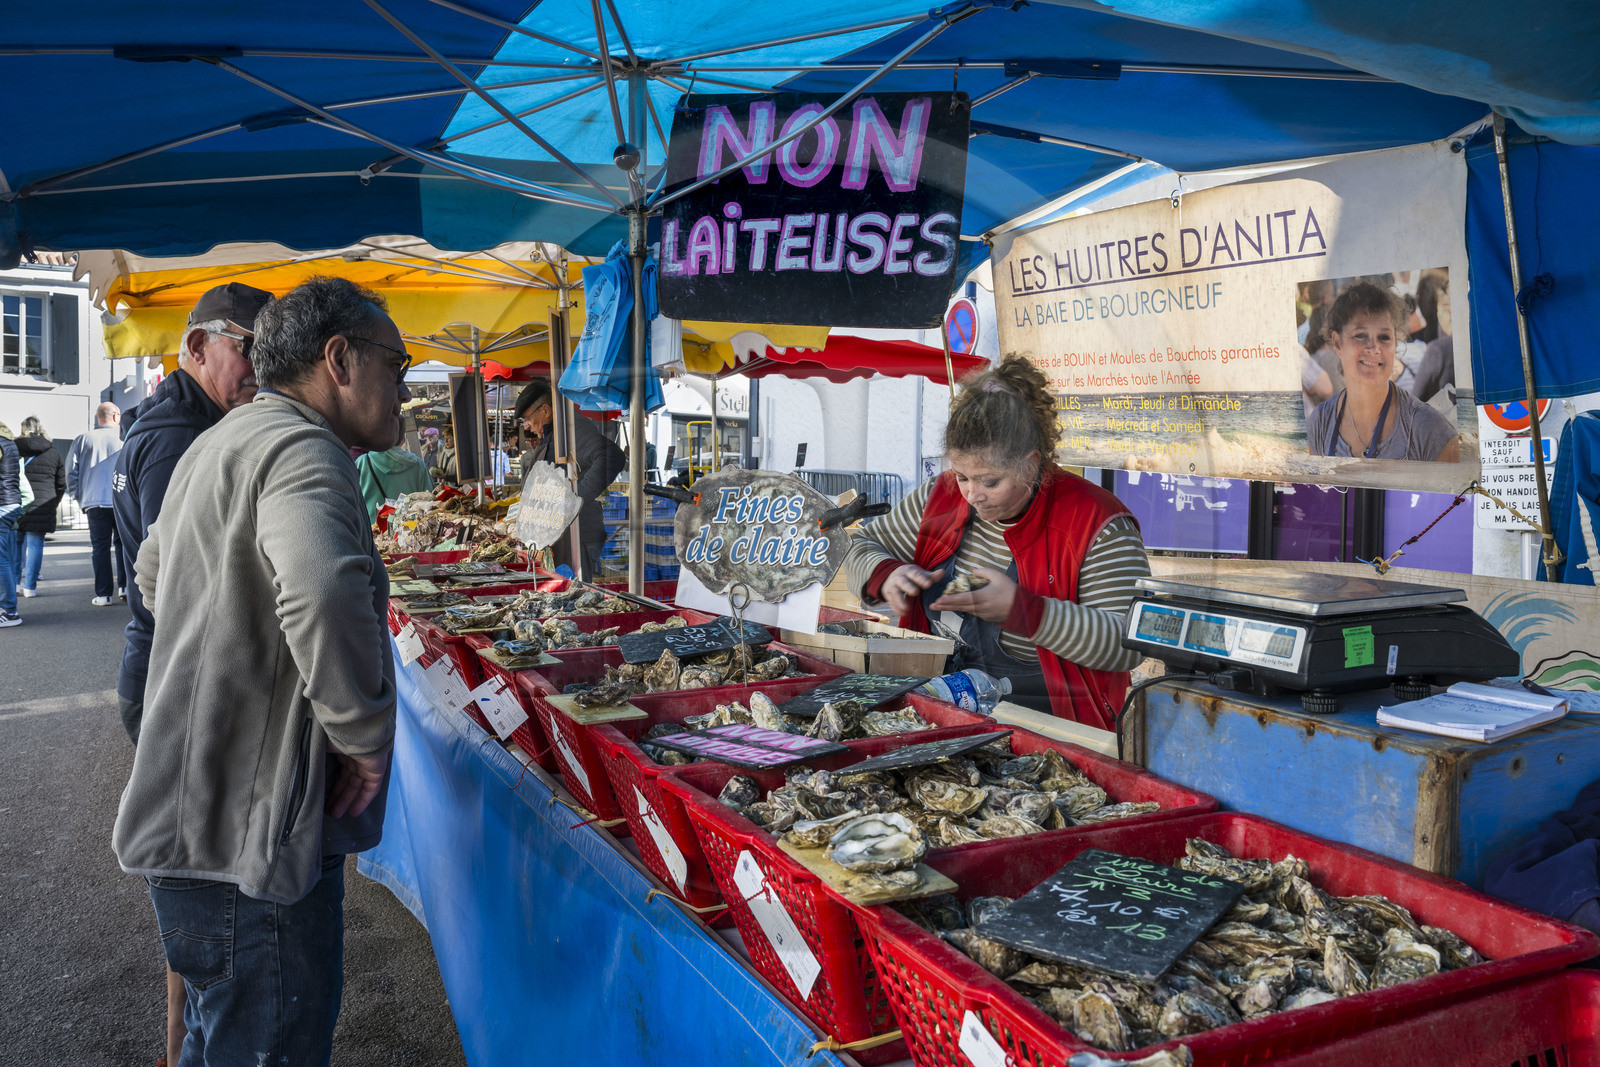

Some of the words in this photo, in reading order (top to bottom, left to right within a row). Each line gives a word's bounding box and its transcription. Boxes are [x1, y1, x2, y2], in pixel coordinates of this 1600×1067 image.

[697, 97, 932, 192] NON
[1009, 254, 1047, 292] LES
[1054, 232, 1168, 286] HUITRES
[1180, 206, 1326, 268] D'ANITA
[1014, 307, 1032, 327] LA
[1036, 301, 1068, 325] BAIE
[1072, 298, 1094, 321] DE
[1100, 282, 1222, 318] BOURGNEUF
[1031, 355, 1049, 368] îtres
[1052, 354, 1061, 368] de
[1063, 352, 1096, 367] BOUIN
[1098, 353, 1107, 366] et
[1110, 349, 1146, 365] Moules
[1149, 348, 1163, 363] de
[1166, 345, 1217, 362] Bouchots
[1220, 342, 1280, 364] garanties
[1057, 378, 1070, 388] sur
[1072, 373, 1085, 388] les
[1087, 371, 1129, 387] Marchés
[1131, 372, 1158, 386] toute
[1160, 369, 1201, 385] l'Année
[721, 393, 748, 413] Stell
[1102, 395, 1137, 411] Mardi,
[1139, 394, 1165, 410] Jeudi
[1167, 396, 1177, 410] et
[1181, 394, 1241, 411] Dimanche
[1106, 416, 1148, 431] Mercredi
[1150, 418, 1160, 432] et
[1162, 417, 1205, 433] Samedi
[1106, 437, 1134, 452] Mardi
[1136, 439, 1145, 453] et
[1148, 439, 1197, 456] Vendredi
[1484, 440, 1521, 448] INTERDIT
[1492, 448, 1513, 456] SAUF
[1481, 475, 1489, 483] SI
[1492, 474, 1515, 483] VOUS
[1519, 473, 1552, 482] PREZ
[1506, 487, 1539, 496] HANDIC
[712, 485, 805, 525] Fines
[1481, 502, 1491, 510] JE
[1521, 501, 1541, 510] LAIS
[1494, 515, 1507, 523] MA
[1511, 515, 1538, 524] PLACE
[685, 525, 724, 564] de
[729, 525, 830, 567] claire
[706, 724, 831, 751] NON
[1182, 874, 1224, 888] de
[1152, 906, 1189, 919] €
